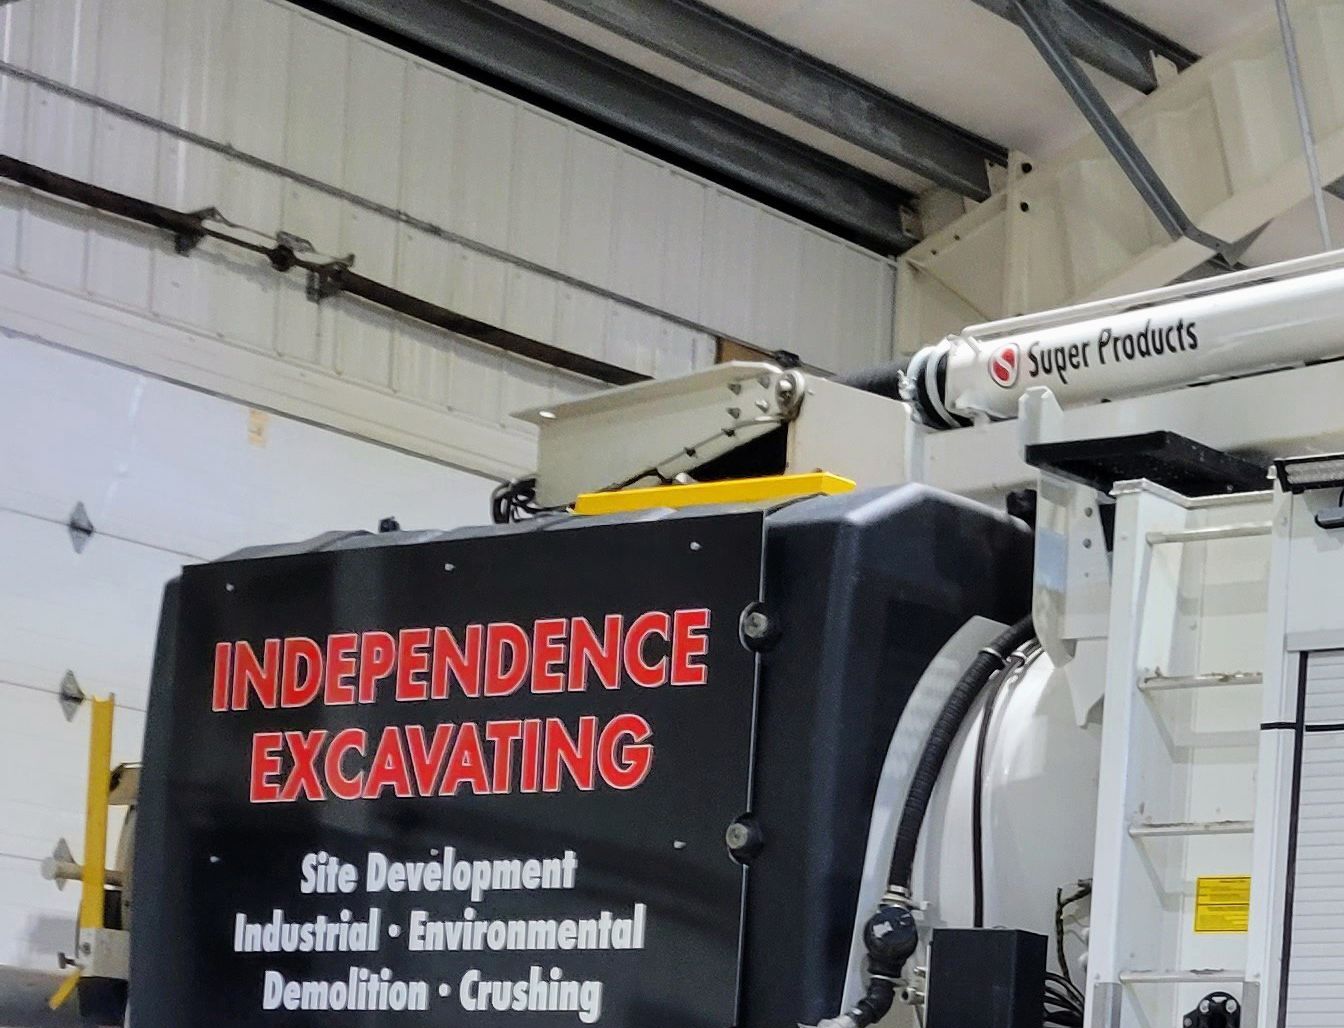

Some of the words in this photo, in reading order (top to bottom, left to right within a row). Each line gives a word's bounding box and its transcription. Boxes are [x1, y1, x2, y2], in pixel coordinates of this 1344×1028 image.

[1027, 340, 1090, 384] Super
[1098, 318, 1199, 365] Products
[211, 608, 710, 712] INDEPENDENCE
[249, 713, 654, 803] EXCAVATING
[301, 851, 358, 894] Site
[366, 846, 578, 902] Development
[233, 907, 382, 953] Industrial
[408, 902, 647, 952] Environmental
[262, 966, 429, 1012] Demolition
[459, 965, 603, 1024] Crushing
